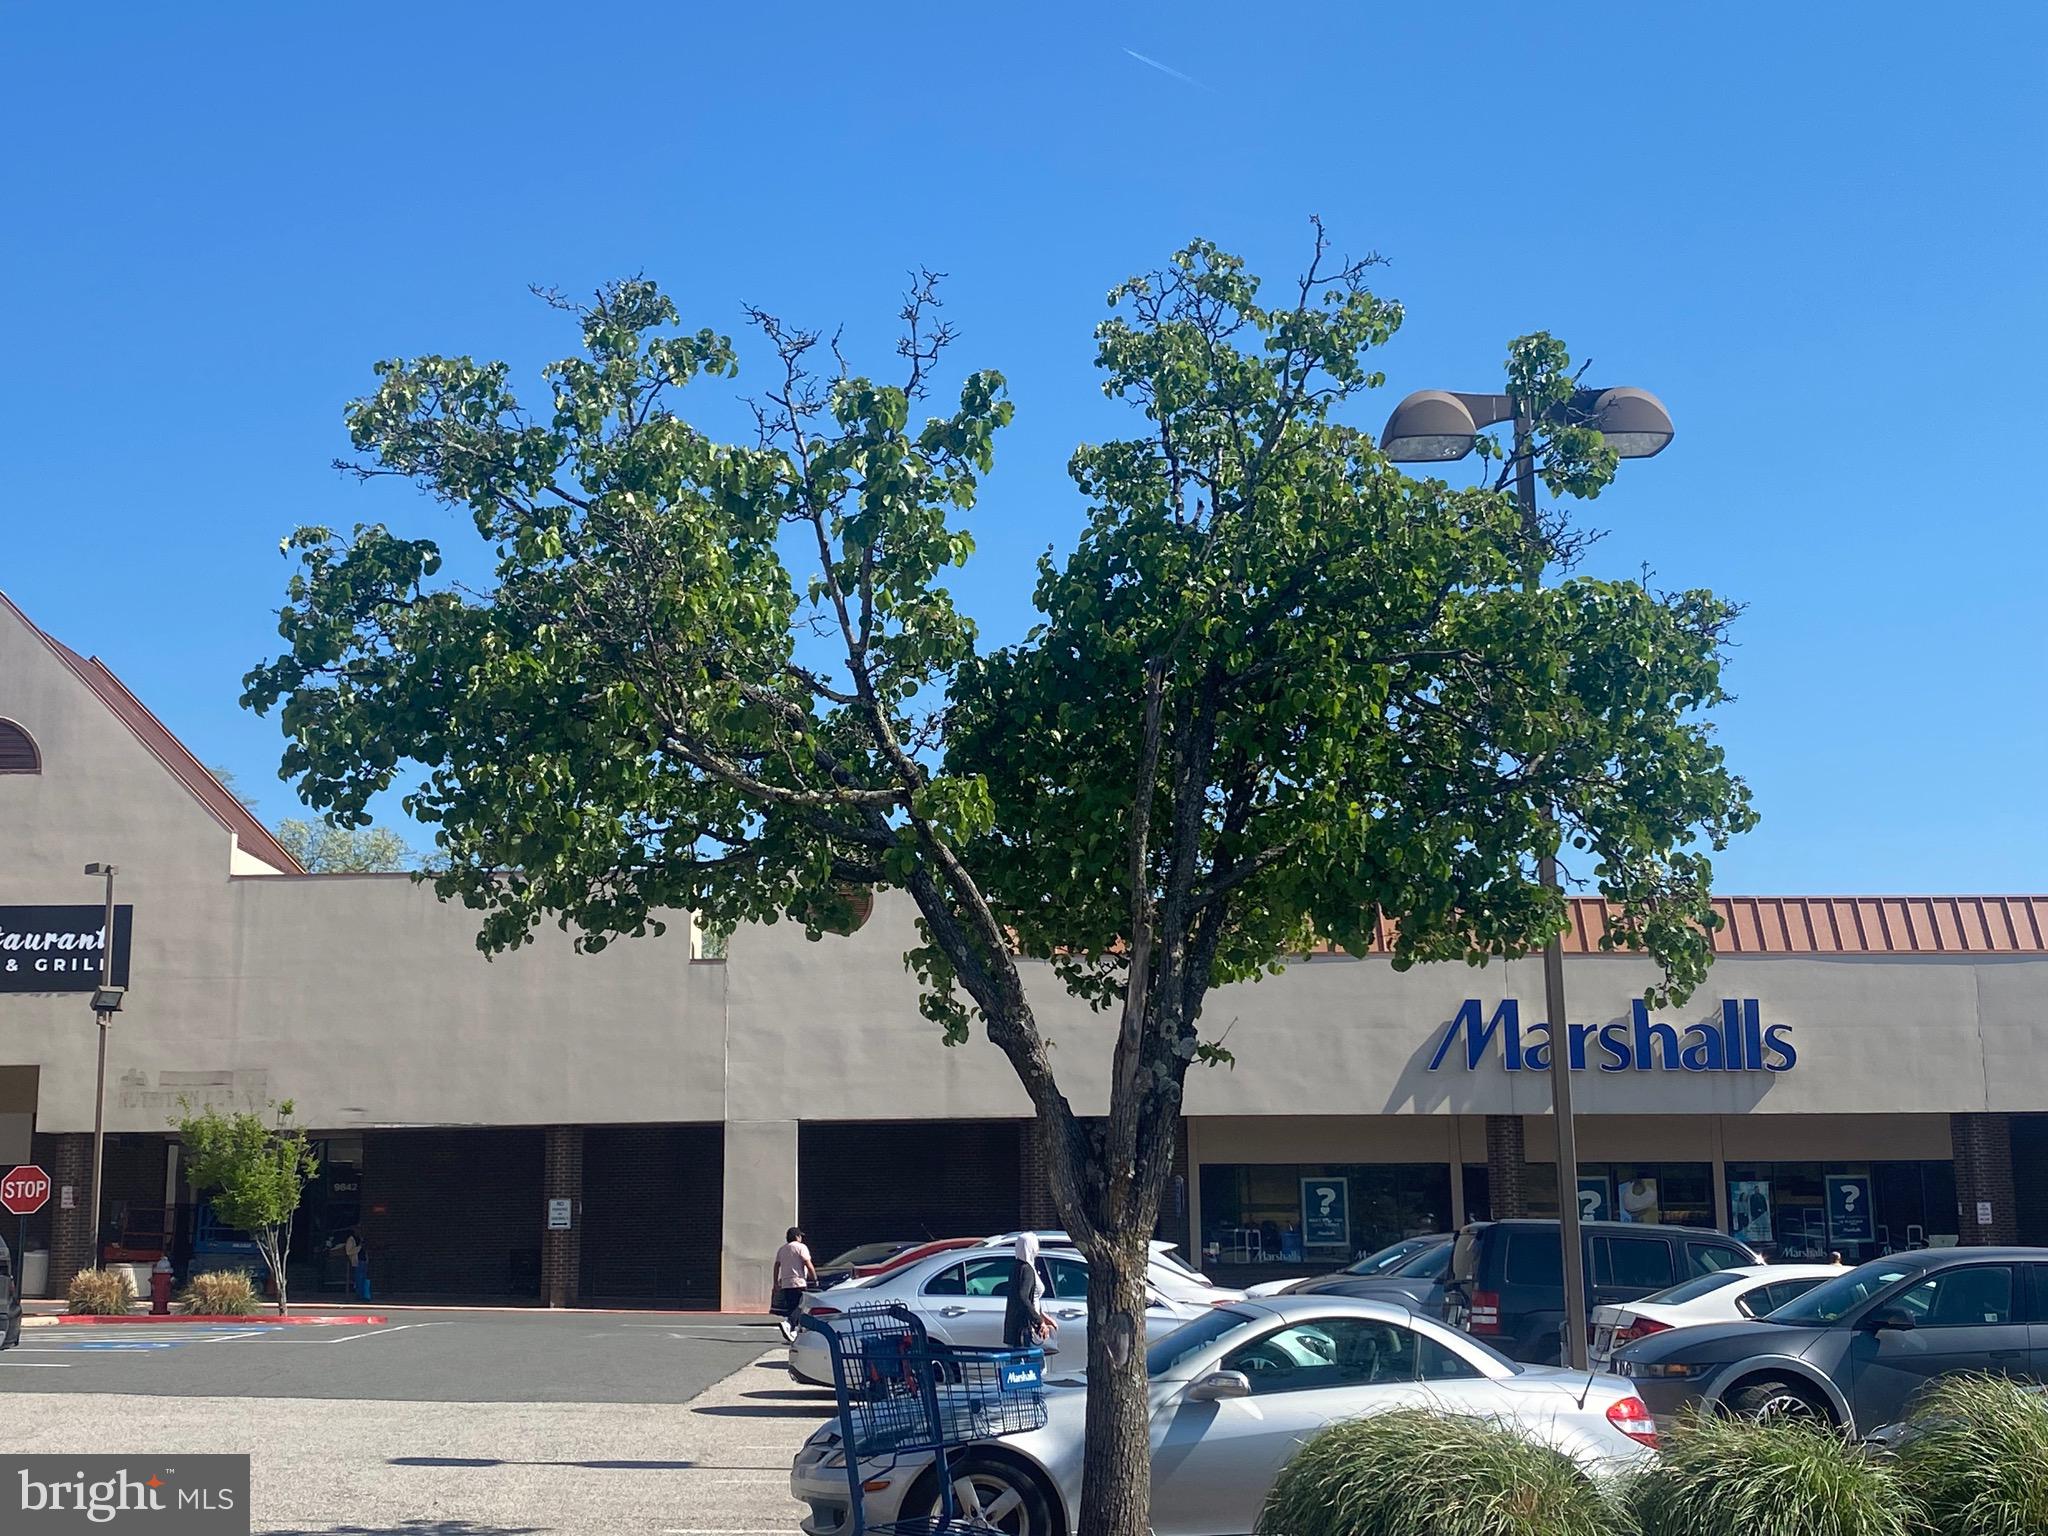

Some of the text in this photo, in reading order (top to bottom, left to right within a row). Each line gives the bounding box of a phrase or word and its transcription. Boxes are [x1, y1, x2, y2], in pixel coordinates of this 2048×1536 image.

[1428, 999, 1798, 1071] Marshalls
[4, 1181, 47, 1199] STOP
[1007, 1369, 1037, 1383] Marshalls
